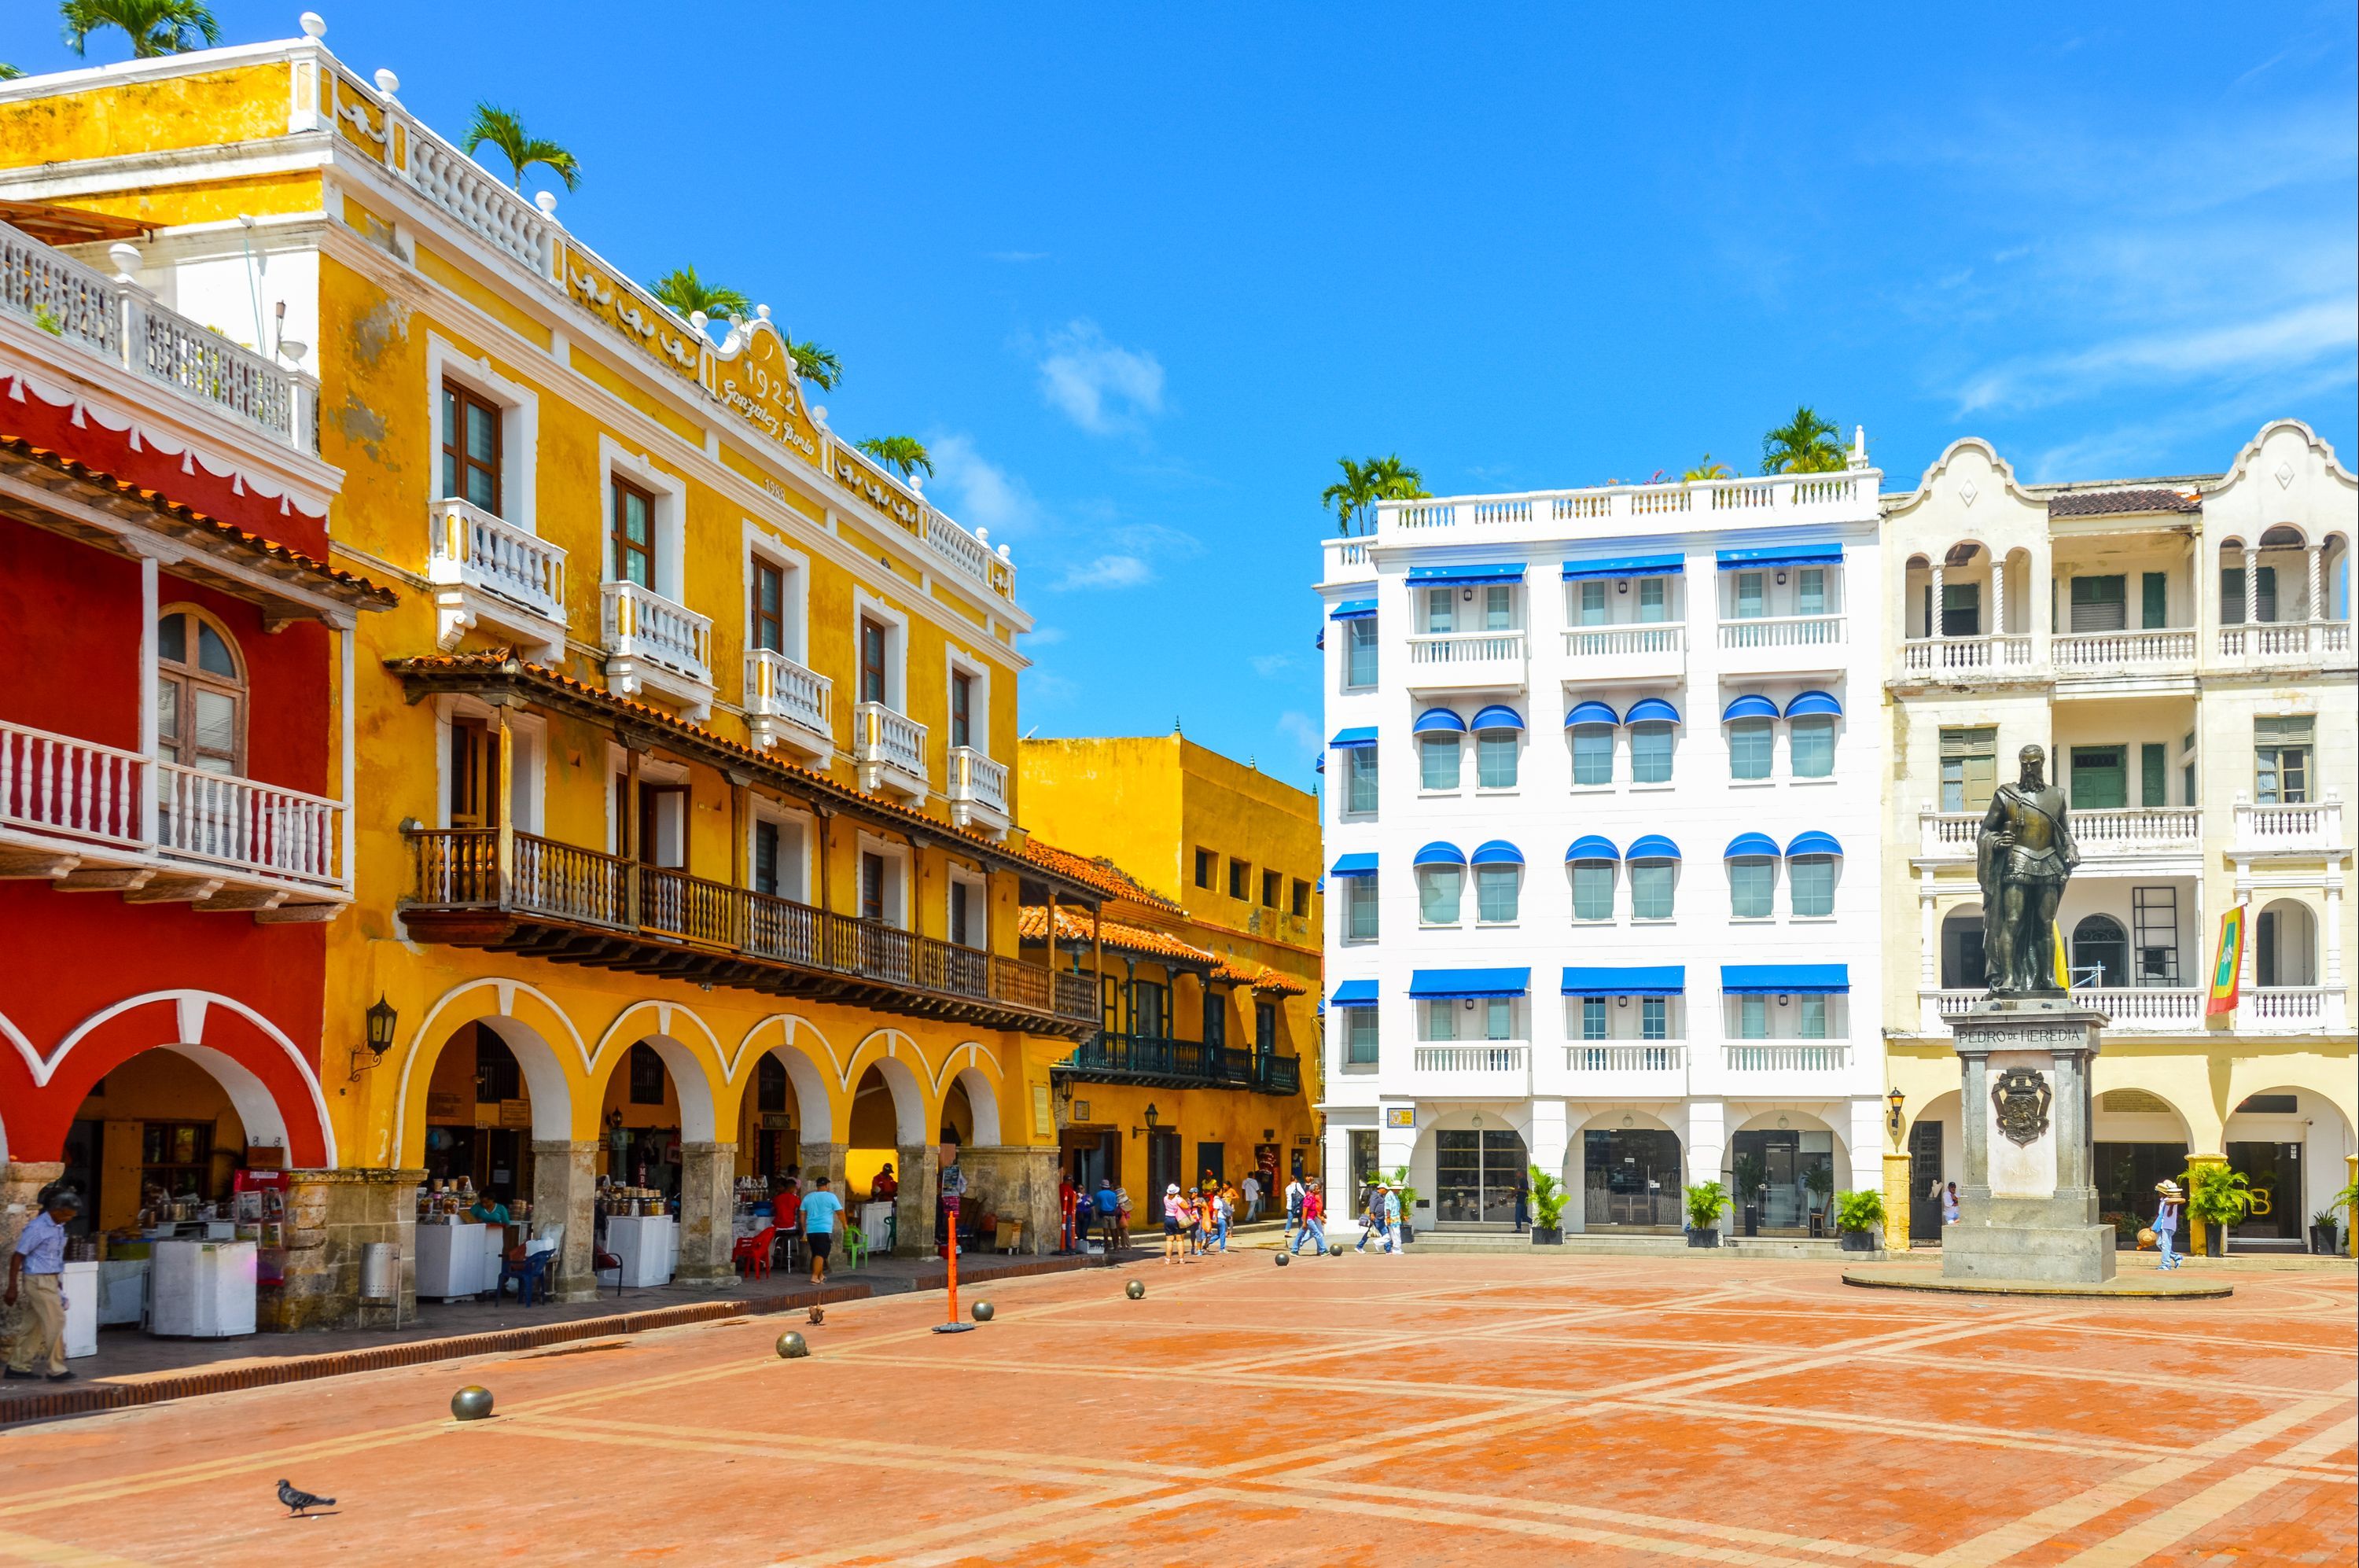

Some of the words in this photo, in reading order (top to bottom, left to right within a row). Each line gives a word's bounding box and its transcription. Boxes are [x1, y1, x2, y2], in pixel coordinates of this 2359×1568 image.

[745, 360, 797, 417] 1922
[1958, 1030, 2006, 1043] PEDRO
[2008, 1032, 2018, 1040] DE
[2020, 1029, 2081, 1043] HEREDIA
